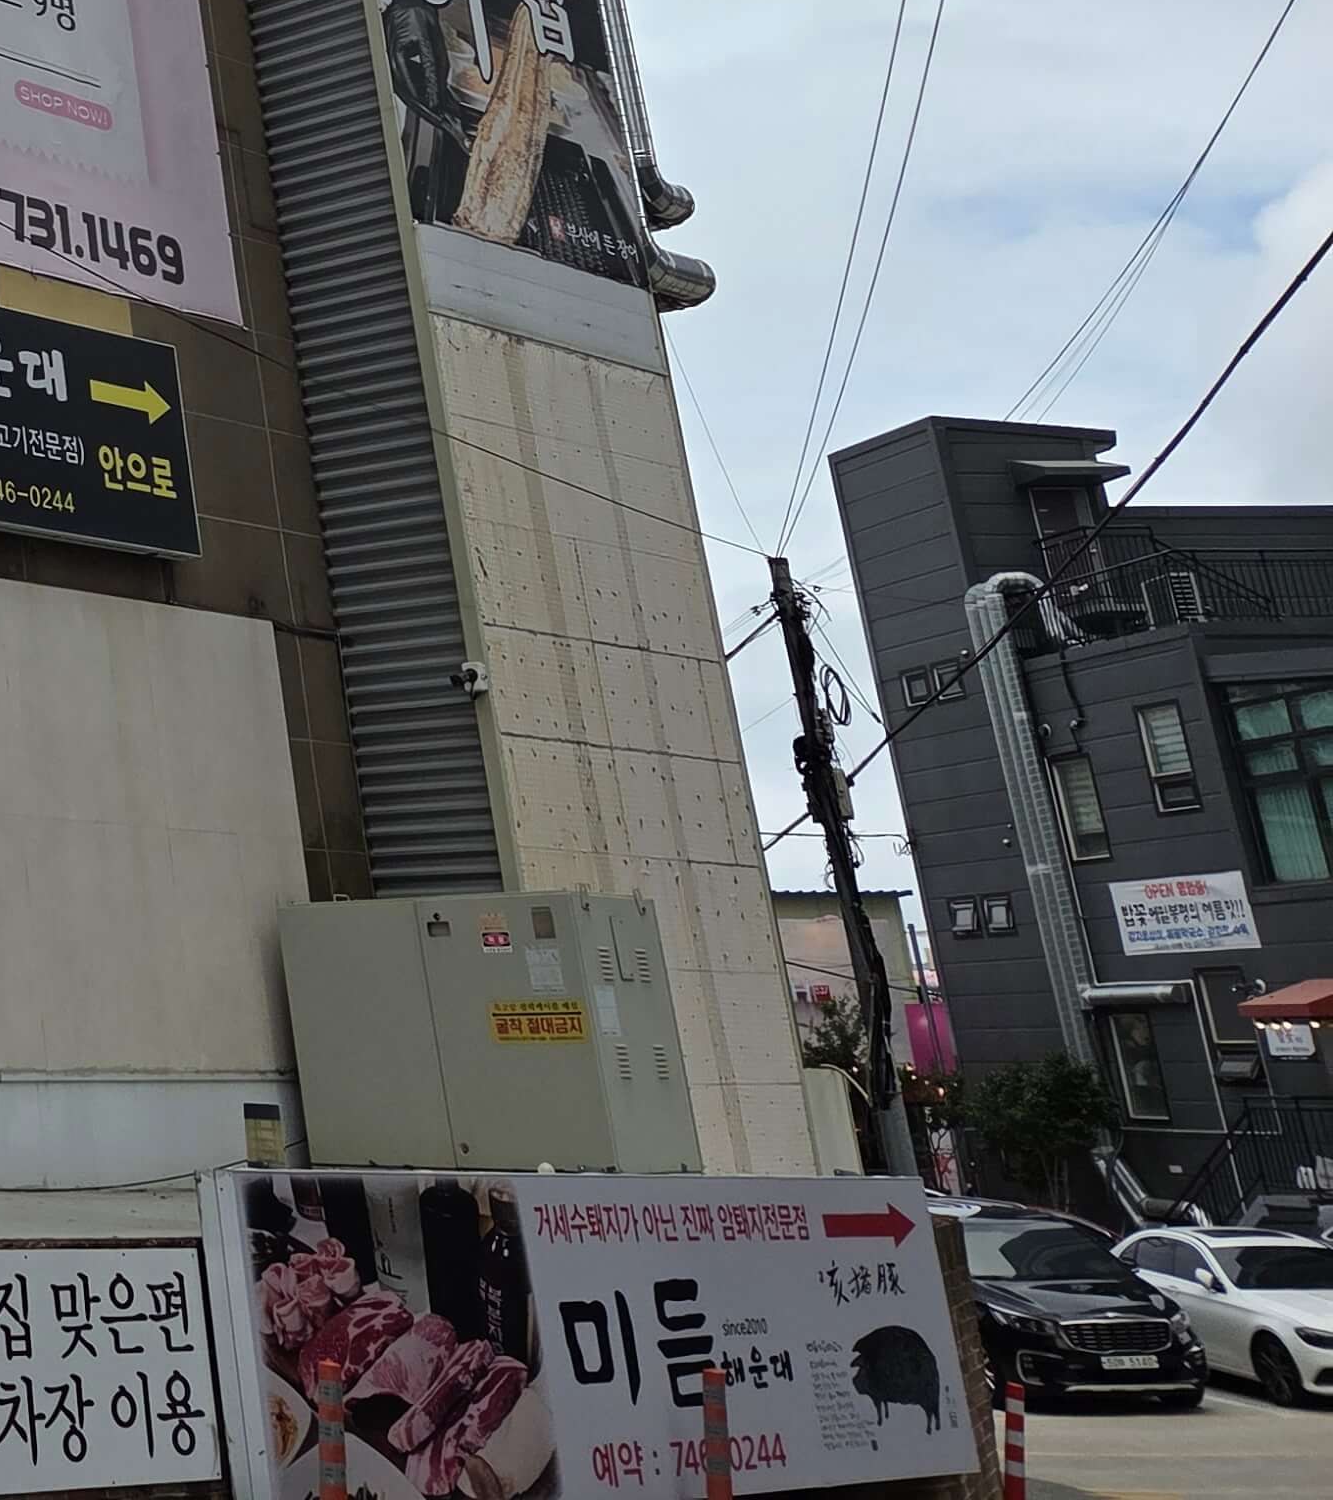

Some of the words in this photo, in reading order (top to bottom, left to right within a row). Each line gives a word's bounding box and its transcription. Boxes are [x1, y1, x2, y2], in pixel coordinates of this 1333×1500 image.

[20, 84, 63, 112] SHOP
[67, 98, 110, 126] NOW!
[98, 445, 177, 499] 안으로
[526, 1016, 583, 1035] 절대금지
[643, 1203, 678, 1242] 아닌
[679, 1203, 715, 1242] 진짜
[50, 1270, 194, 1359] 맞은편
[721, 1346, 794, 1389] 해운대
[110, 1369, 205, 1460] 이용
